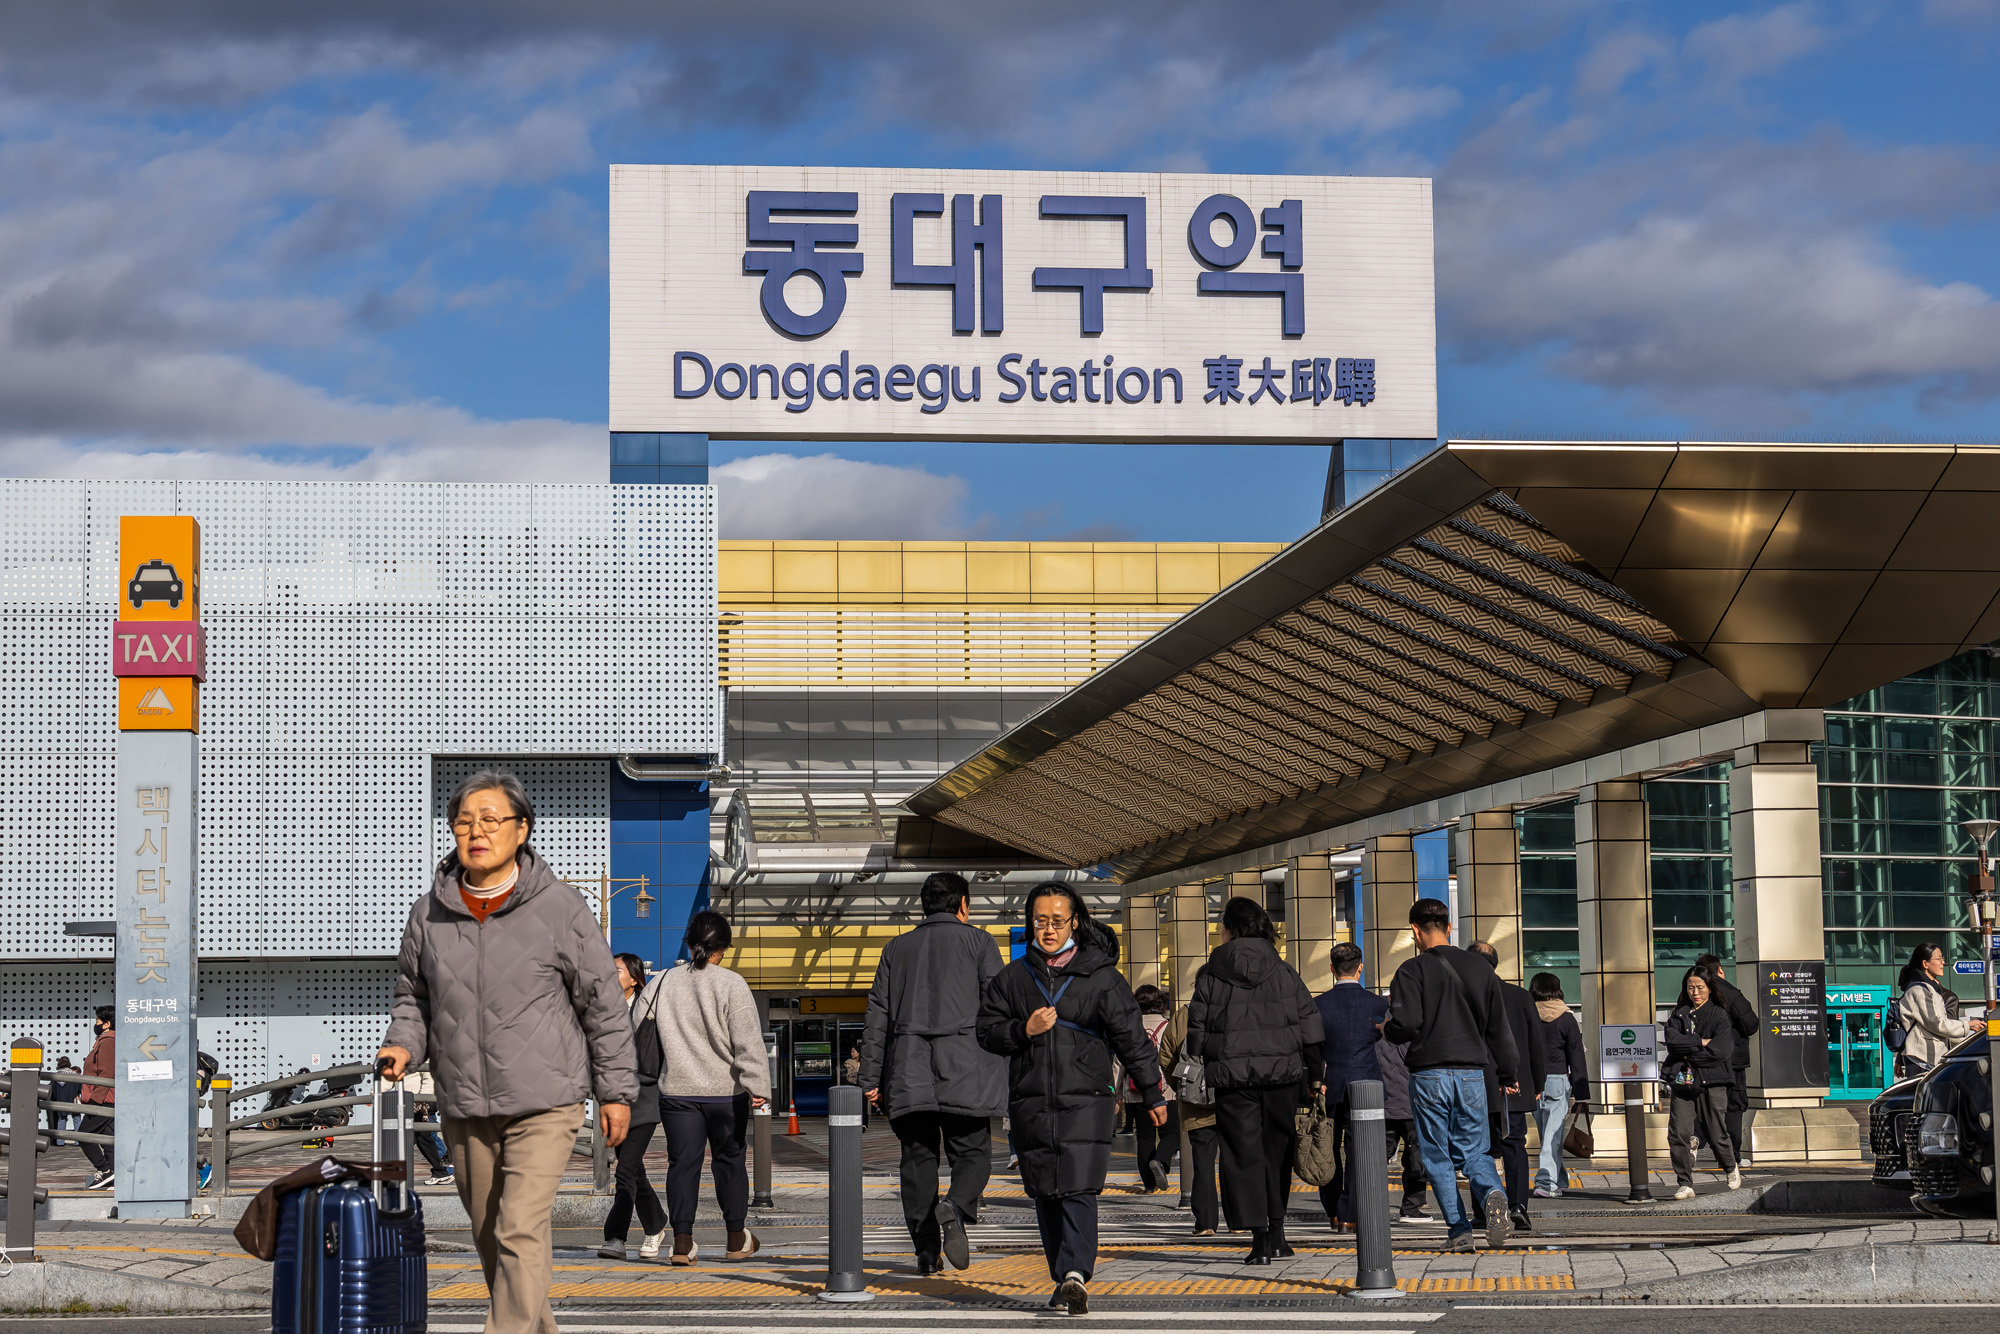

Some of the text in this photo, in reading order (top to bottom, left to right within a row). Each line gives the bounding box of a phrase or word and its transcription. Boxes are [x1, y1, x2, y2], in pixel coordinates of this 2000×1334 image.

[743, 190, 1306, 340] 동대구역
[674, 350, 1377, 415] Dongdaegu Station 東大邱驛
[117, 634, 192, 663] TAXI
[134, 787, 171, 984] 택시타는곳
[126, 998, 178, 1013] 동대구역
[809, 999, 817, 1012] 3
[1841, 993, 1871, 1003] iM뱅크
[124, 1015, 181, 1024] Dongdaegu Stn.
[1606, 1047, 1652, 1056] 흡연구역 가는길
